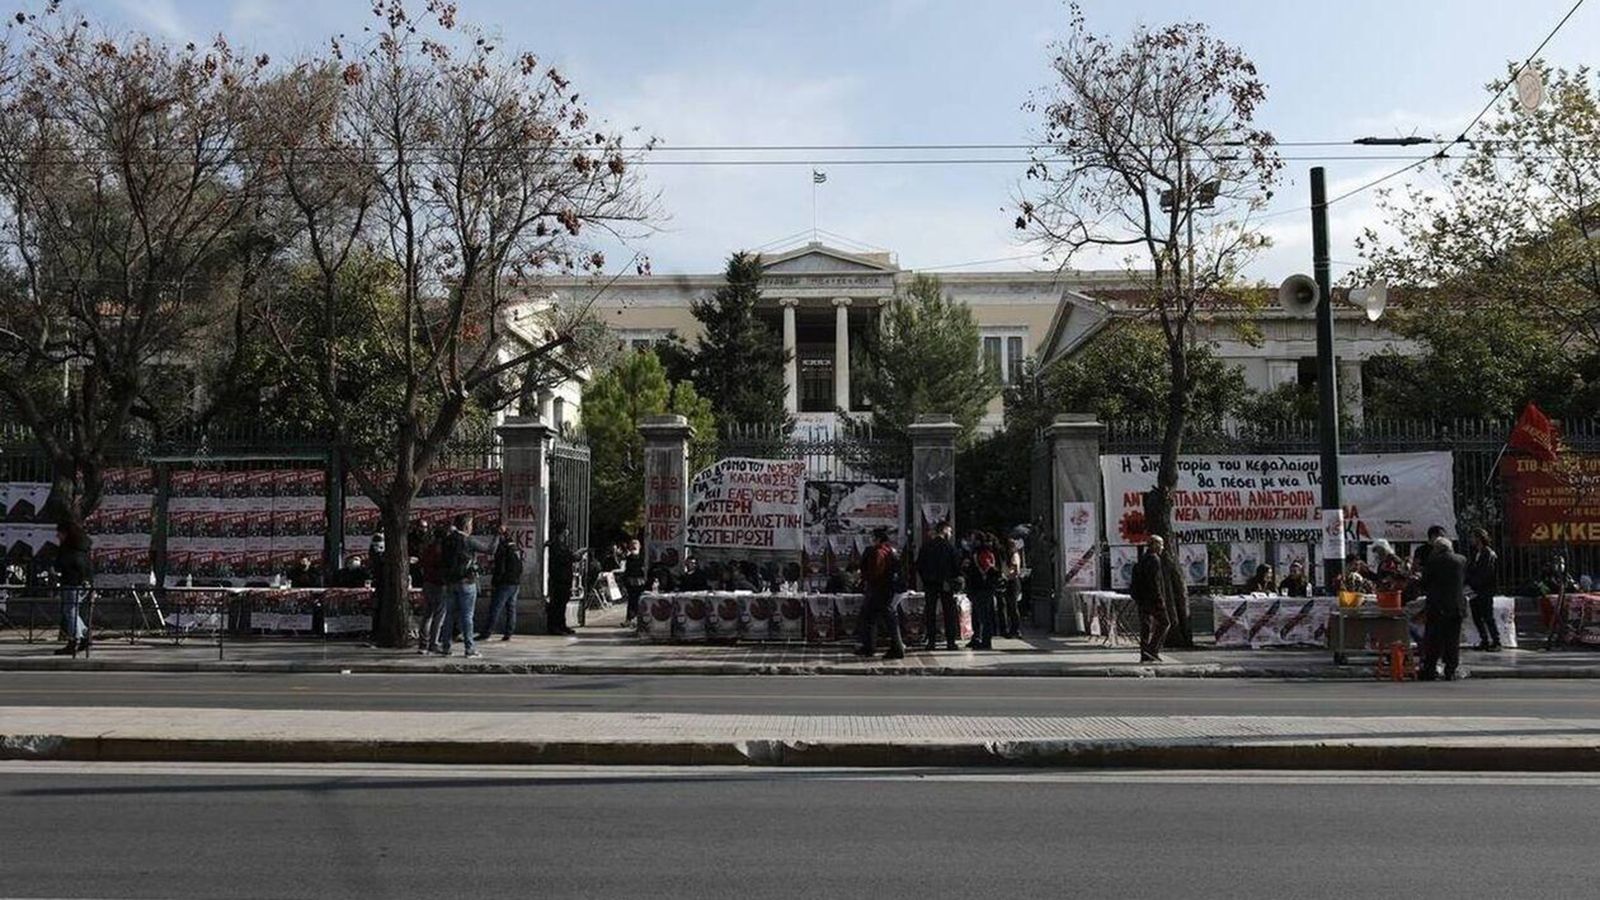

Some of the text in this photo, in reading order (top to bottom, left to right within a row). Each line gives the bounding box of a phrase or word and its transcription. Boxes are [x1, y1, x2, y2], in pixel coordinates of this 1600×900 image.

[1122, 456, 1132, 473] Η
[1140, 455, 1211, 476] δικτορία
[1218, 460, 1241, 471] του
[1197, 472, 1217, 488] θα
[1261, 477, 1276, 490] με
[1306, 471, 1392, 486] Ποτεχνεία
[1248, 490, 1315, 507] ΑΝΑΤΡΟΠΗ
[508, 505, 536, 520] ΗΠΑ
[1175, 508, 1201, 521] ΝΕΑ
[1208, 507, 1308, 521] ΚΟΜΜΟΥΝΙΣΤΙΚΗ
[687, 529, 774, 546] ΣΥΣΠΕΙΡΩΣΗ
[1551, 521, 1600, 541] ΚΚΕ
